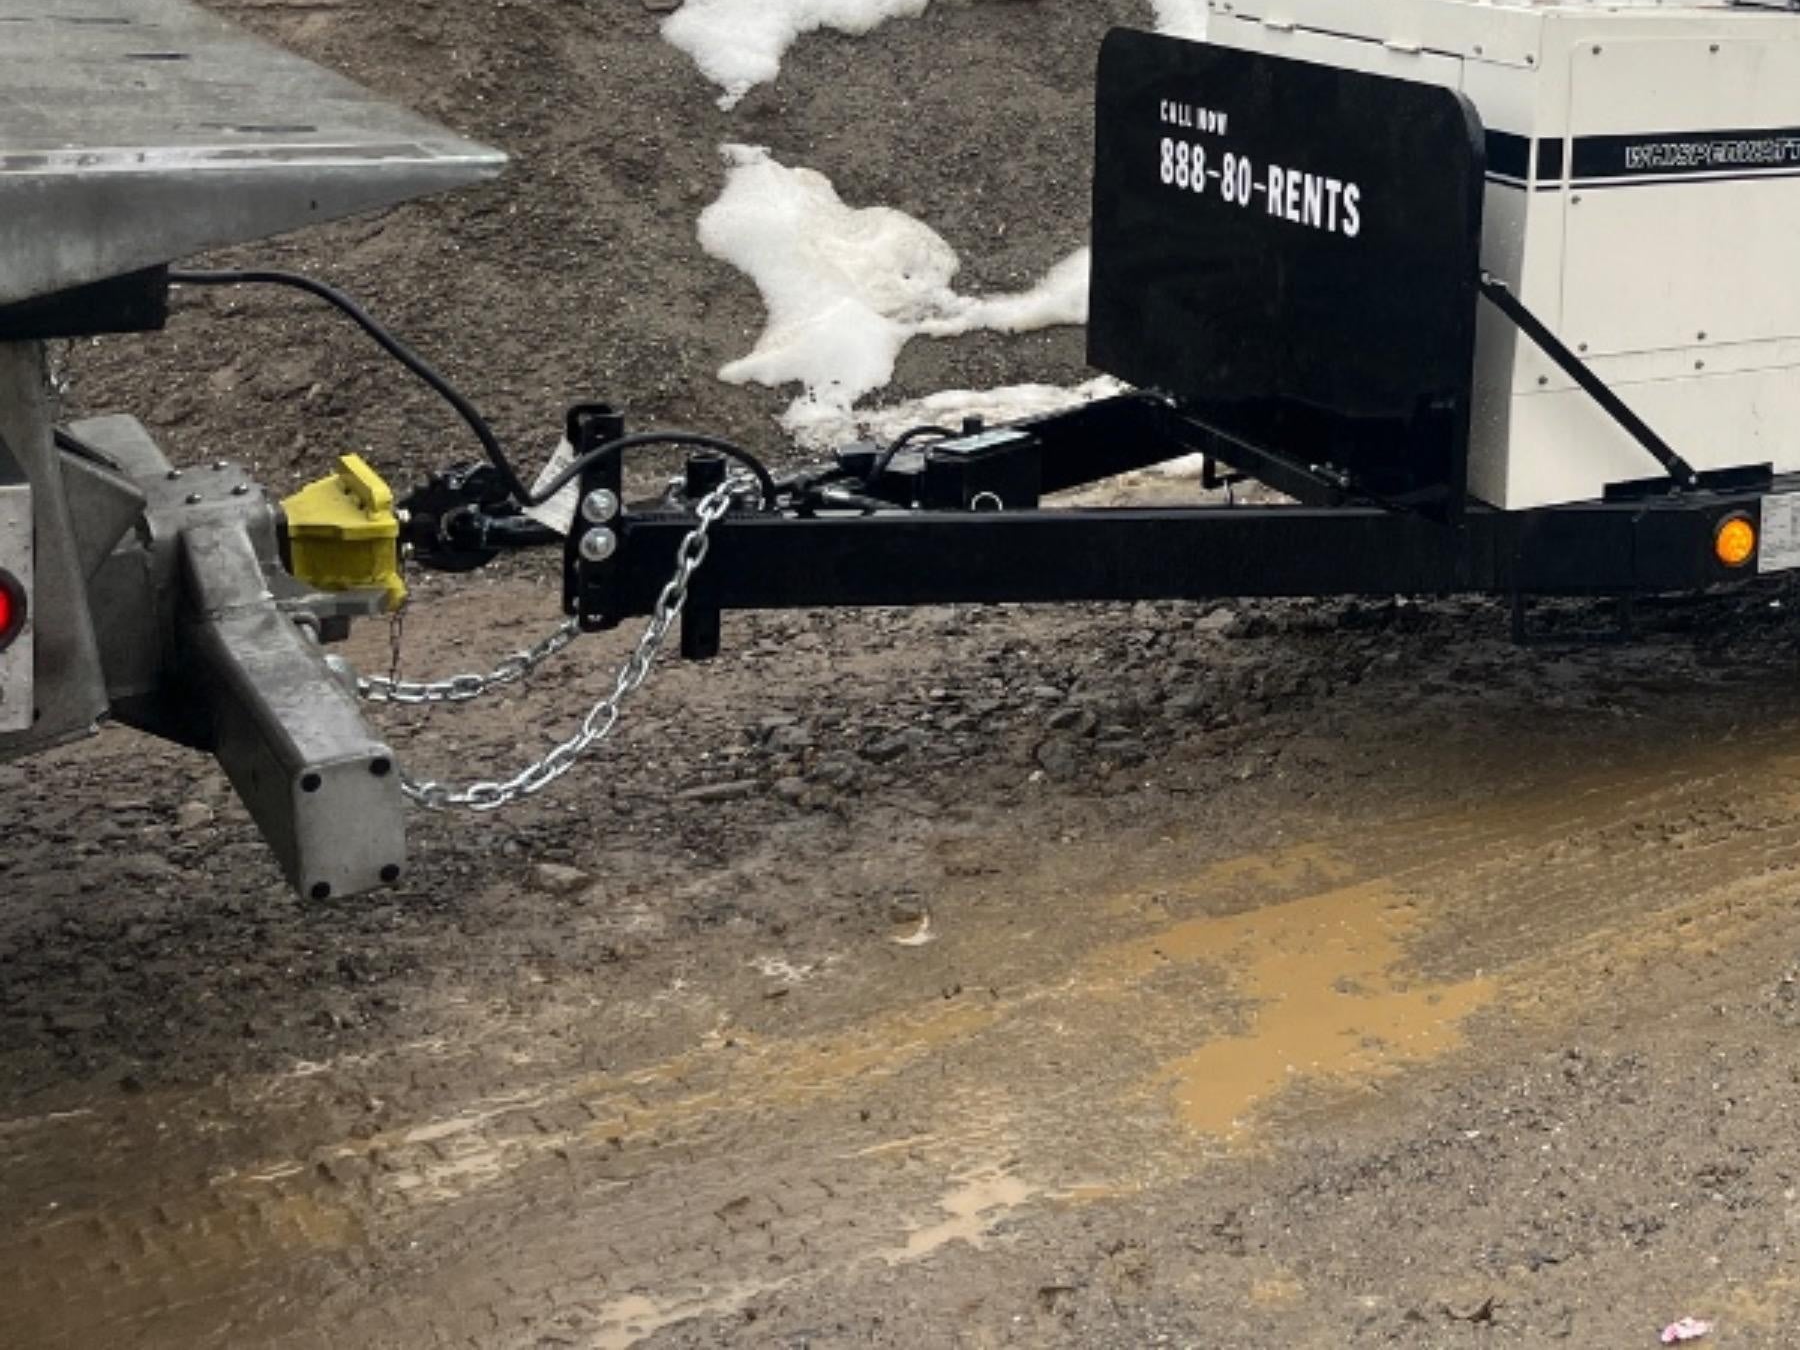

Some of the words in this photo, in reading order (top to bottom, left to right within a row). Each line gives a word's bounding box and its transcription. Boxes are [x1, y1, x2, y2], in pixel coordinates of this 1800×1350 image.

[1160, 100, 1192, 127] CALL
[1196, 107, 1228, 136] NOW
[1160, 137, 1361, 238] 888-80-RENTS
